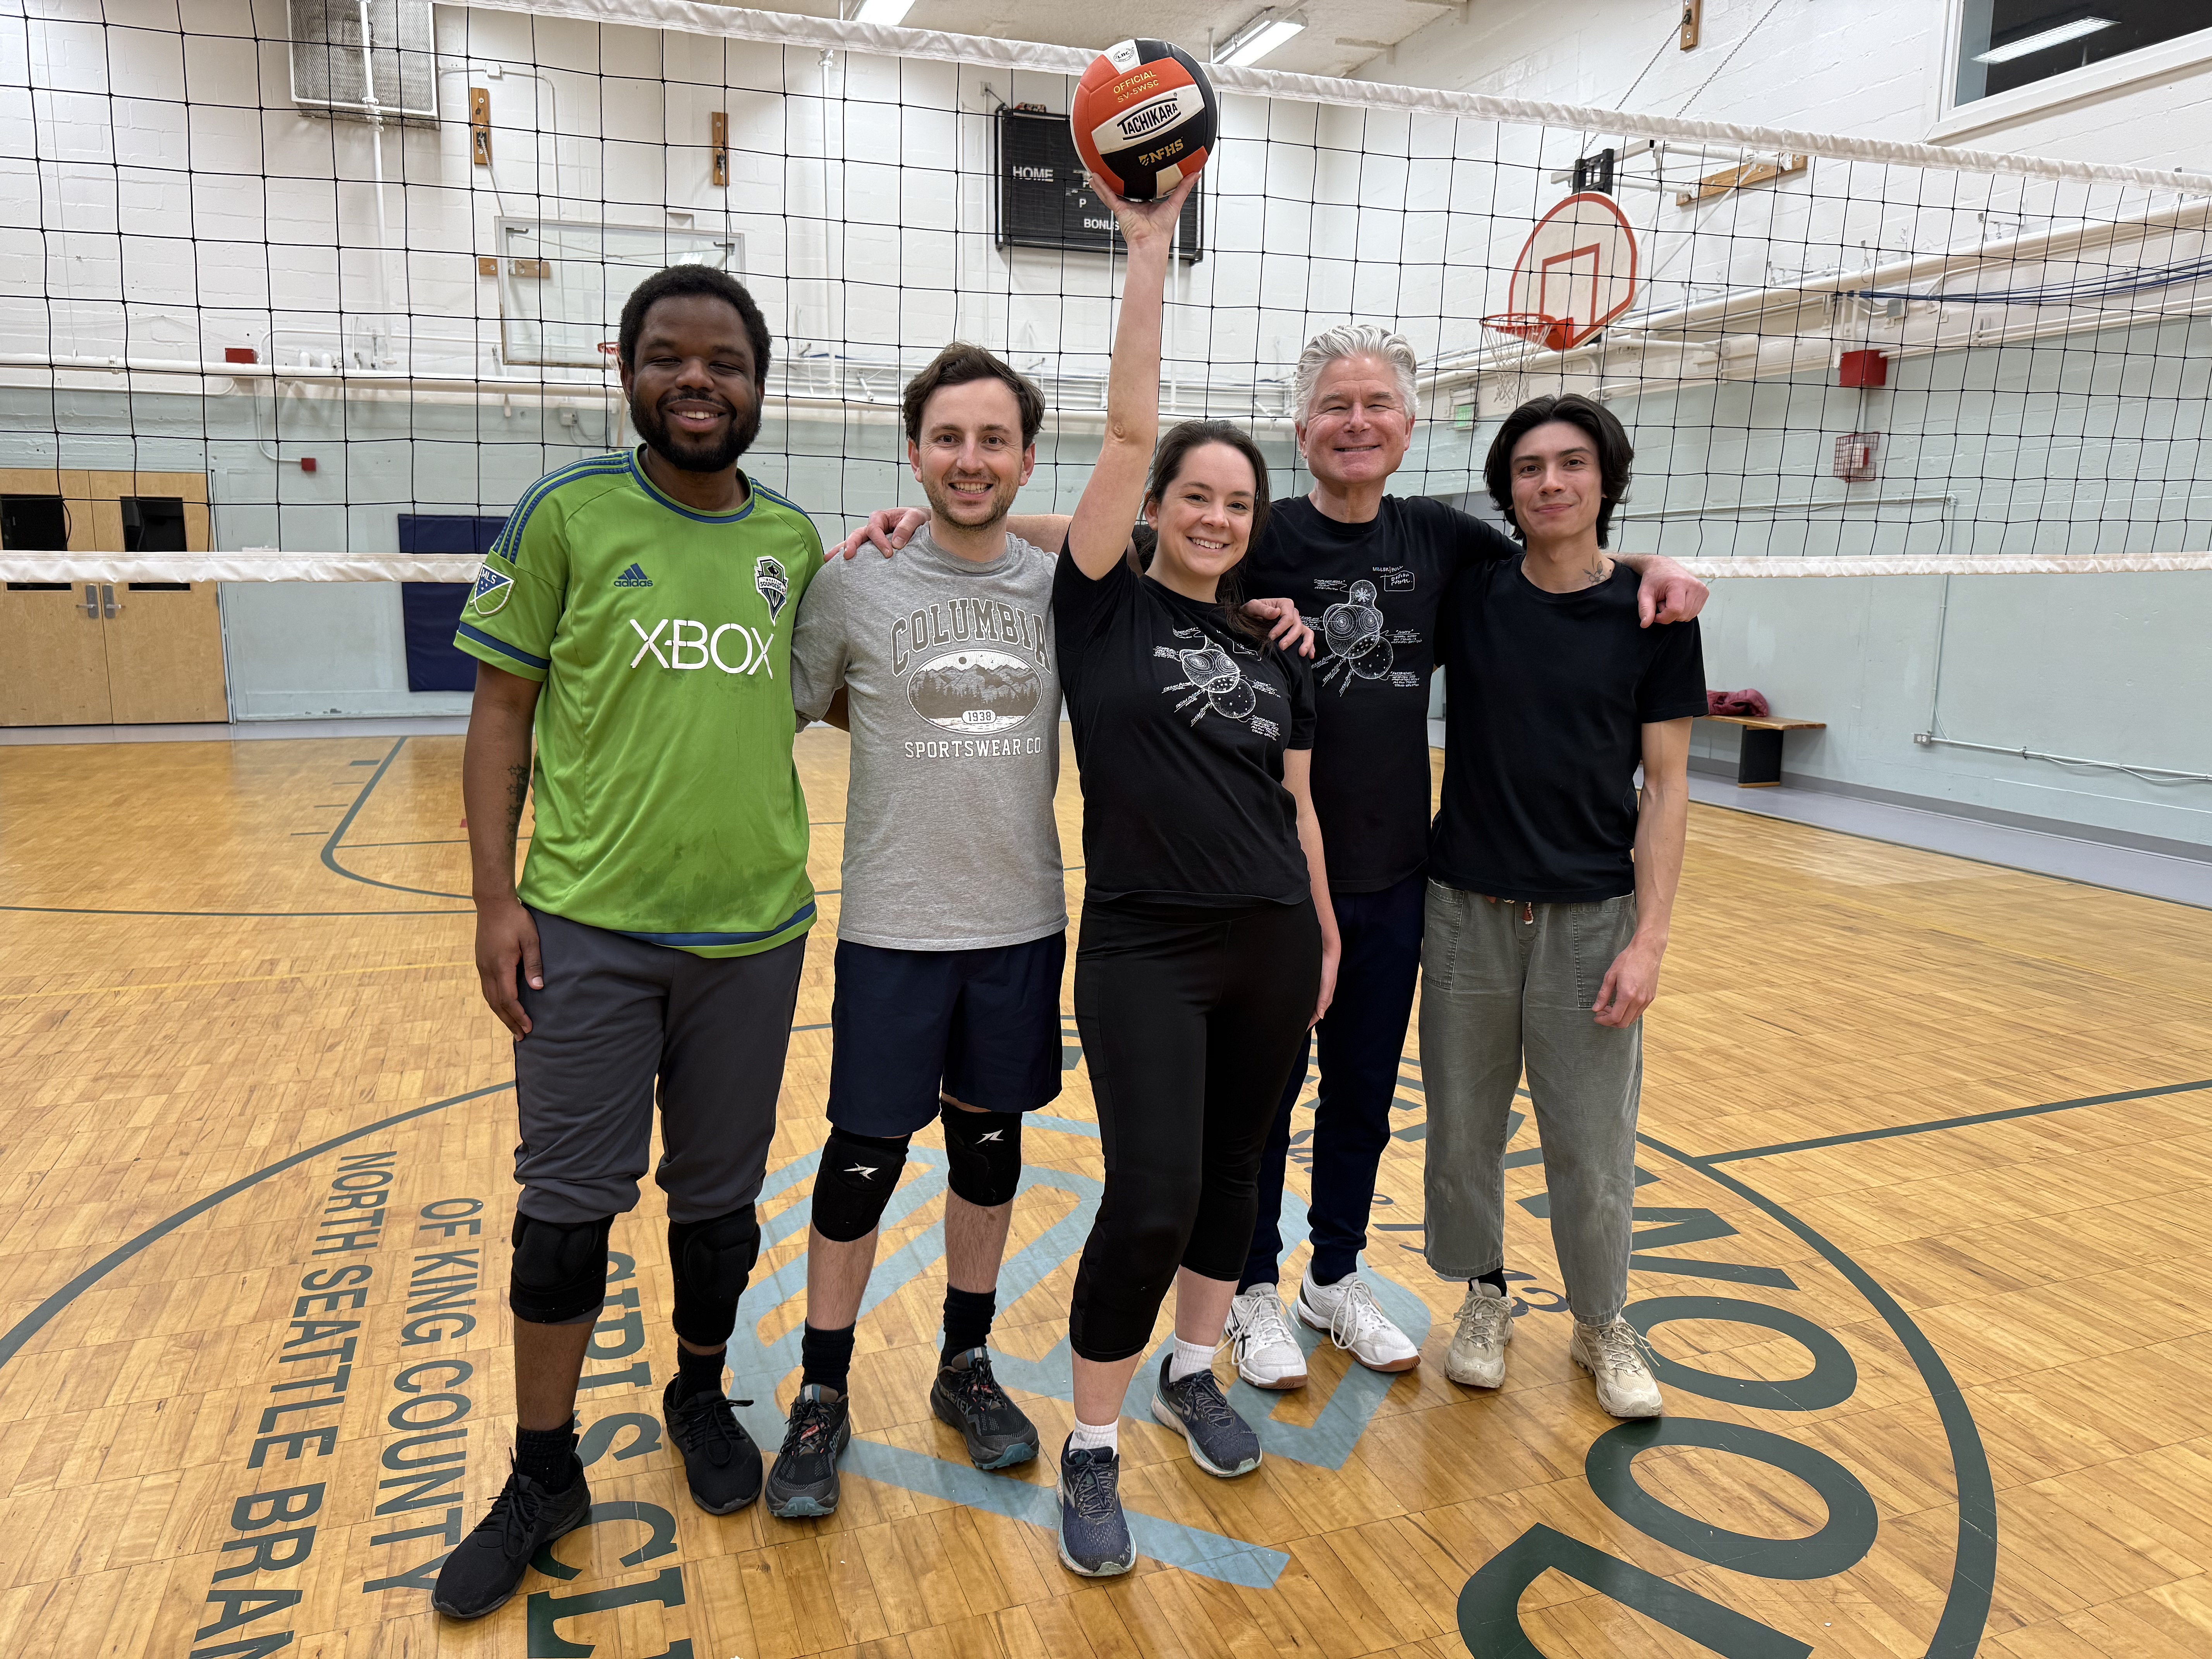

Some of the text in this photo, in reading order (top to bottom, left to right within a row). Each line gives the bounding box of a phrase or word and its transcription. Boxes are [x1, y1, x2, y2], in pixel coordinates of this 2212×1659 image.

[1113, 70, 1157, 94] OFFICIAL
[1117, 79, 1159, 103] SV-5WSC
[1116, 102, 1178, 135] TACHIKARA
[1149, 138, 1184, 163] NFHS
[1013, 166, 1054, 182] HOME
[481, 568, 497, 584] MLS
[613, 579, 654, 587] adidas
[890, 598, 1052, 678] COLUMBIA
[968, 712, 991, 722] 1938
[905, 737, 1043, 759] SPORTSWEAR CO.
[311, 1150, 397, 1255] NORTH
[418, 1198, 484, 1242] OF
[400, 1249, 480, 1347] KING
[247, 1264, 374, 1470] SEATTLE
